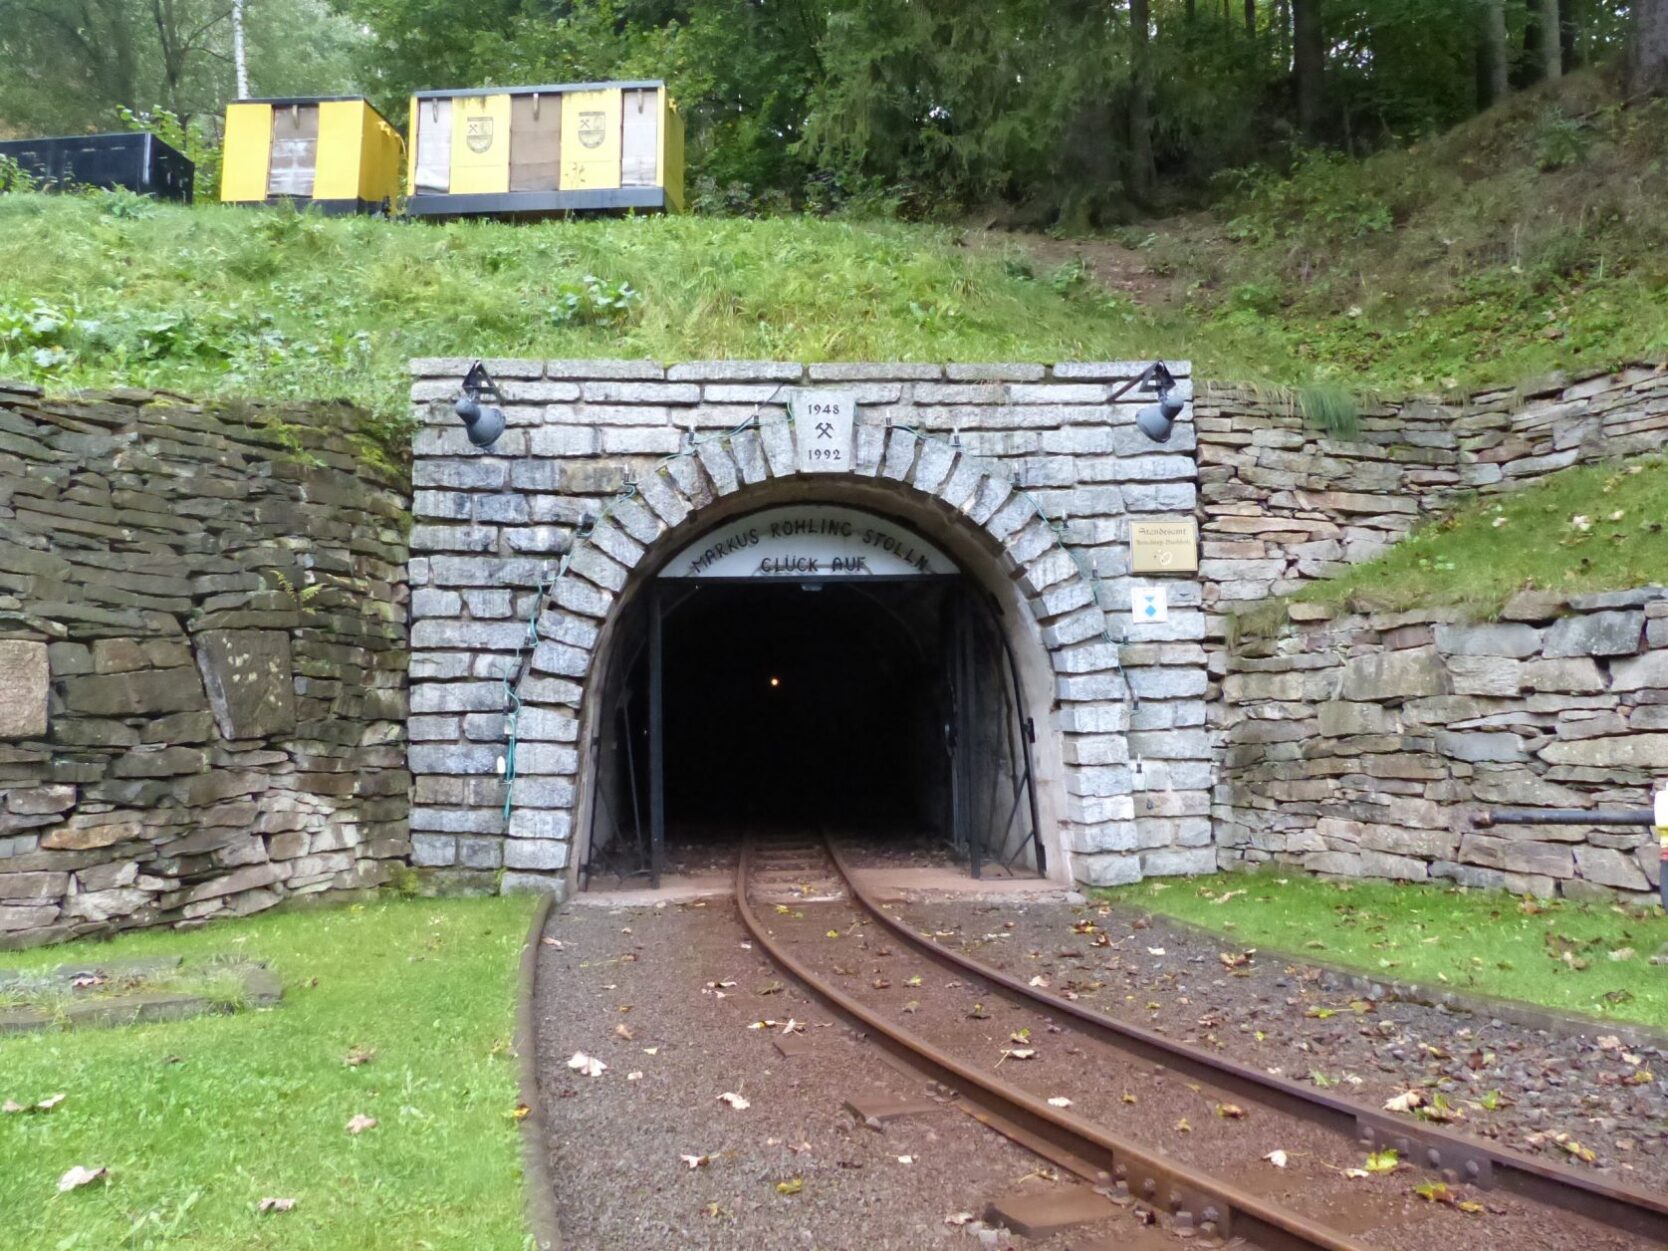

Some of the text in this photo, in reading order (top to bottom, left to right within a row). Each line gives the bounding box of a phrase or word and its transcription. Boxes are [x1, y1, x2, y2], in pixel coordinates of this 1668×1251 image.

[808, 404, 840, 415] 1948
[808, 449, 841, 460] 1992
[691, 528, 759, 573] MARKUS
[862, 529, 929, 571] STOLLN
[831, 556, 866, 572] AUF
